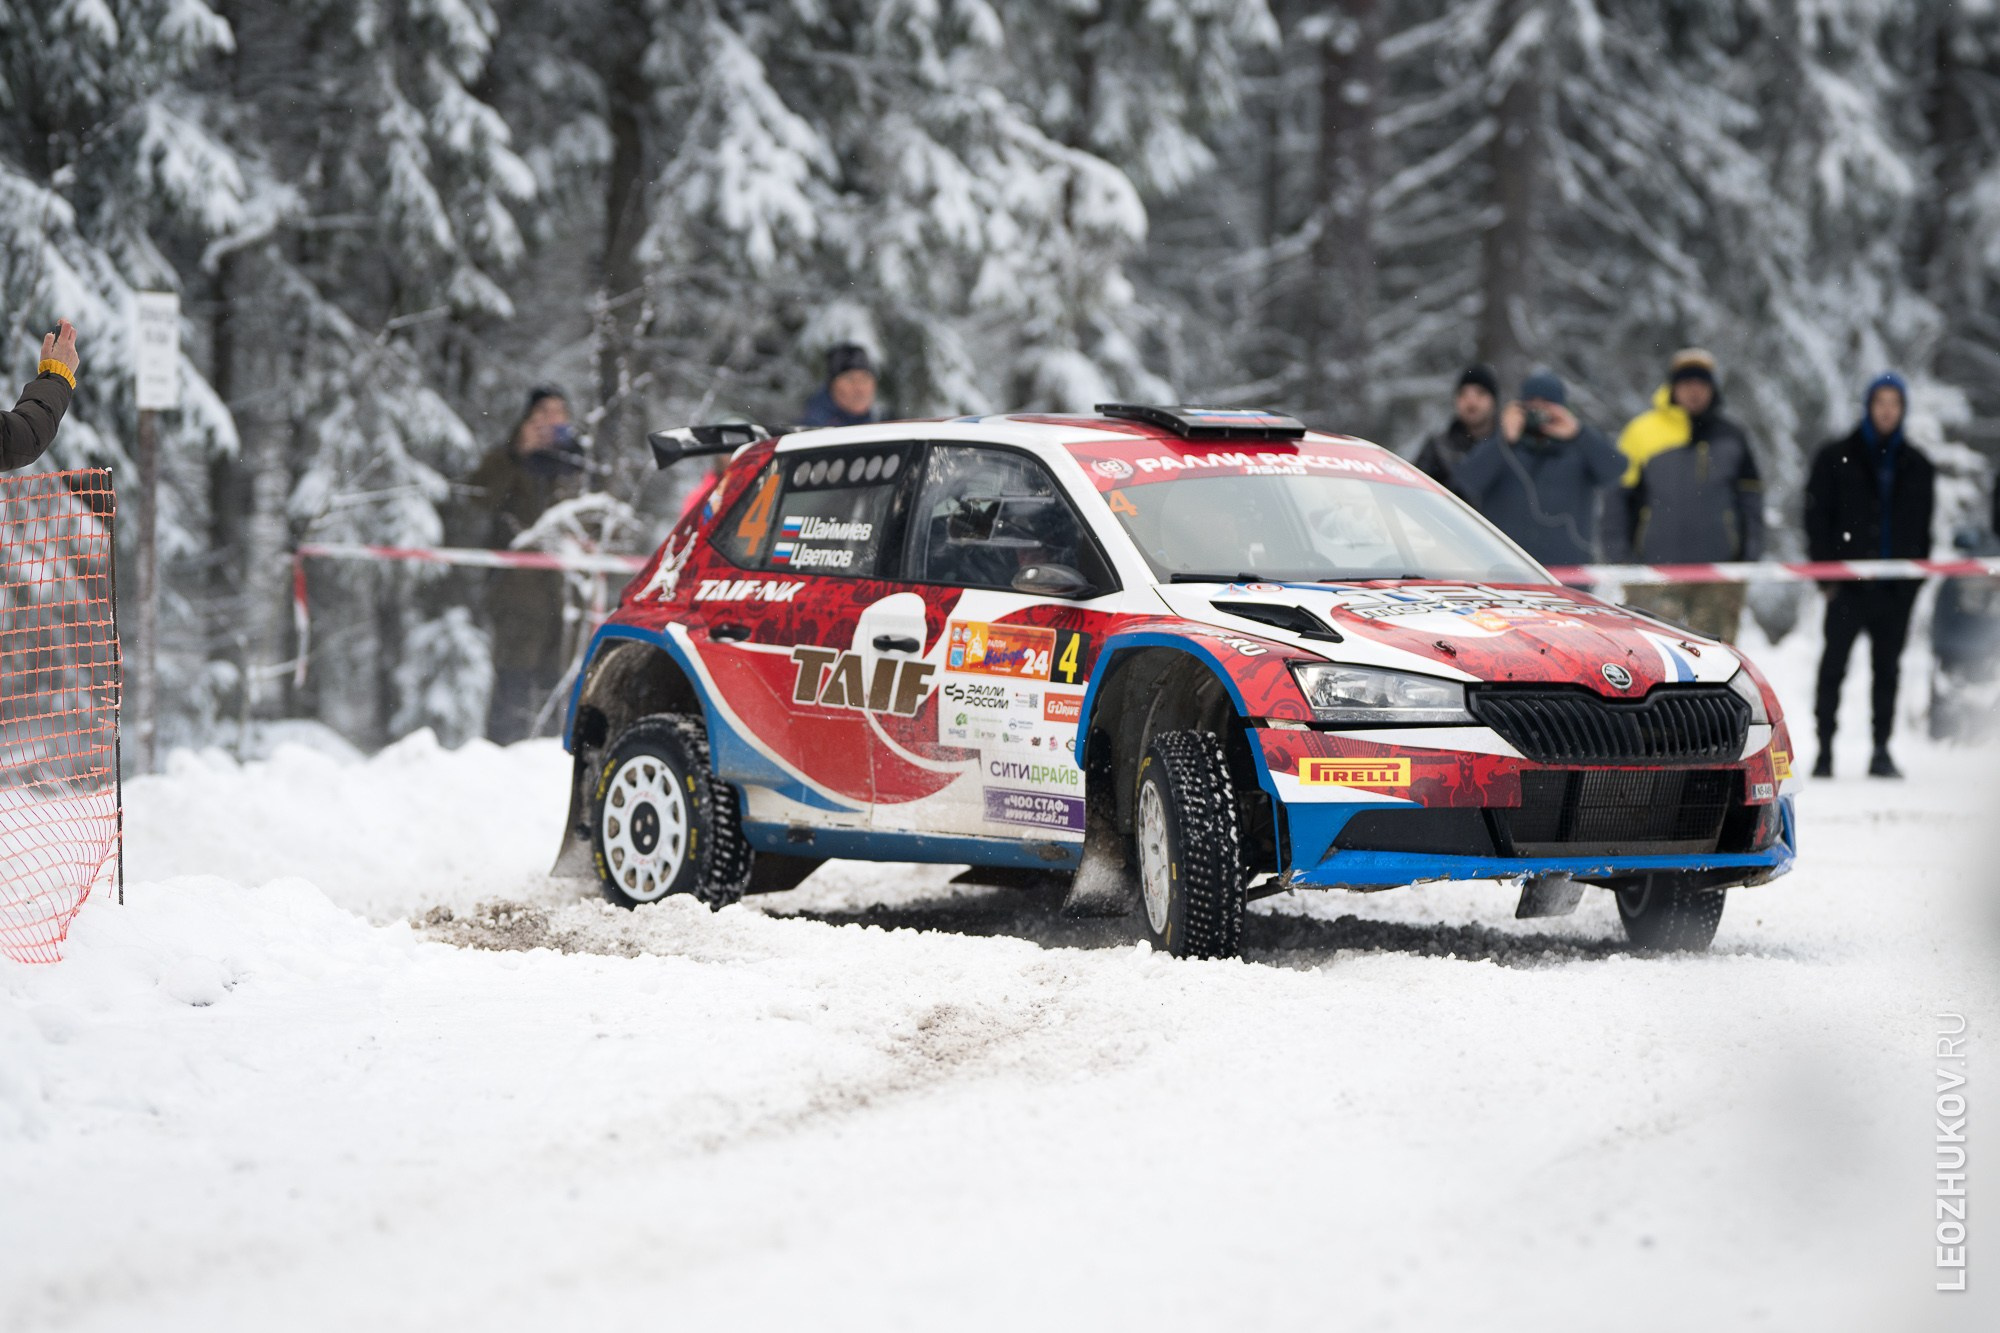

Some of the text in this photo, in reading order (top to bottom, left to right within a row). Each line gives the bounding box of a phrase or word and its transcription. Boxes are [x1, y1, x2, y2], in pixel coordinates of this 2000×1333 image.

[1135, 453, 1255, 473] РАЛЛИ
[1256, 453, 1384, 475] РОССИИ
[736, 474, 780, 556] 4
[1109, 489, 1138, 517] 4
[798, 516, 873, 541] Шаймиев
[789, 542, 854, 569] Цветков
[1020, 647, 1049, 676] 24
[1058, 632, 1080, 684] 4
[792, 647, 936, 715] TAIF
[966, 684, 1005, 697] РАЛЛИ
[964, 696, 1009, 709] РОССИИ
[990, 761, 1079, 785] СИТИДРАЙВ
[1310, 763, 1401, 782] PIRELLI
